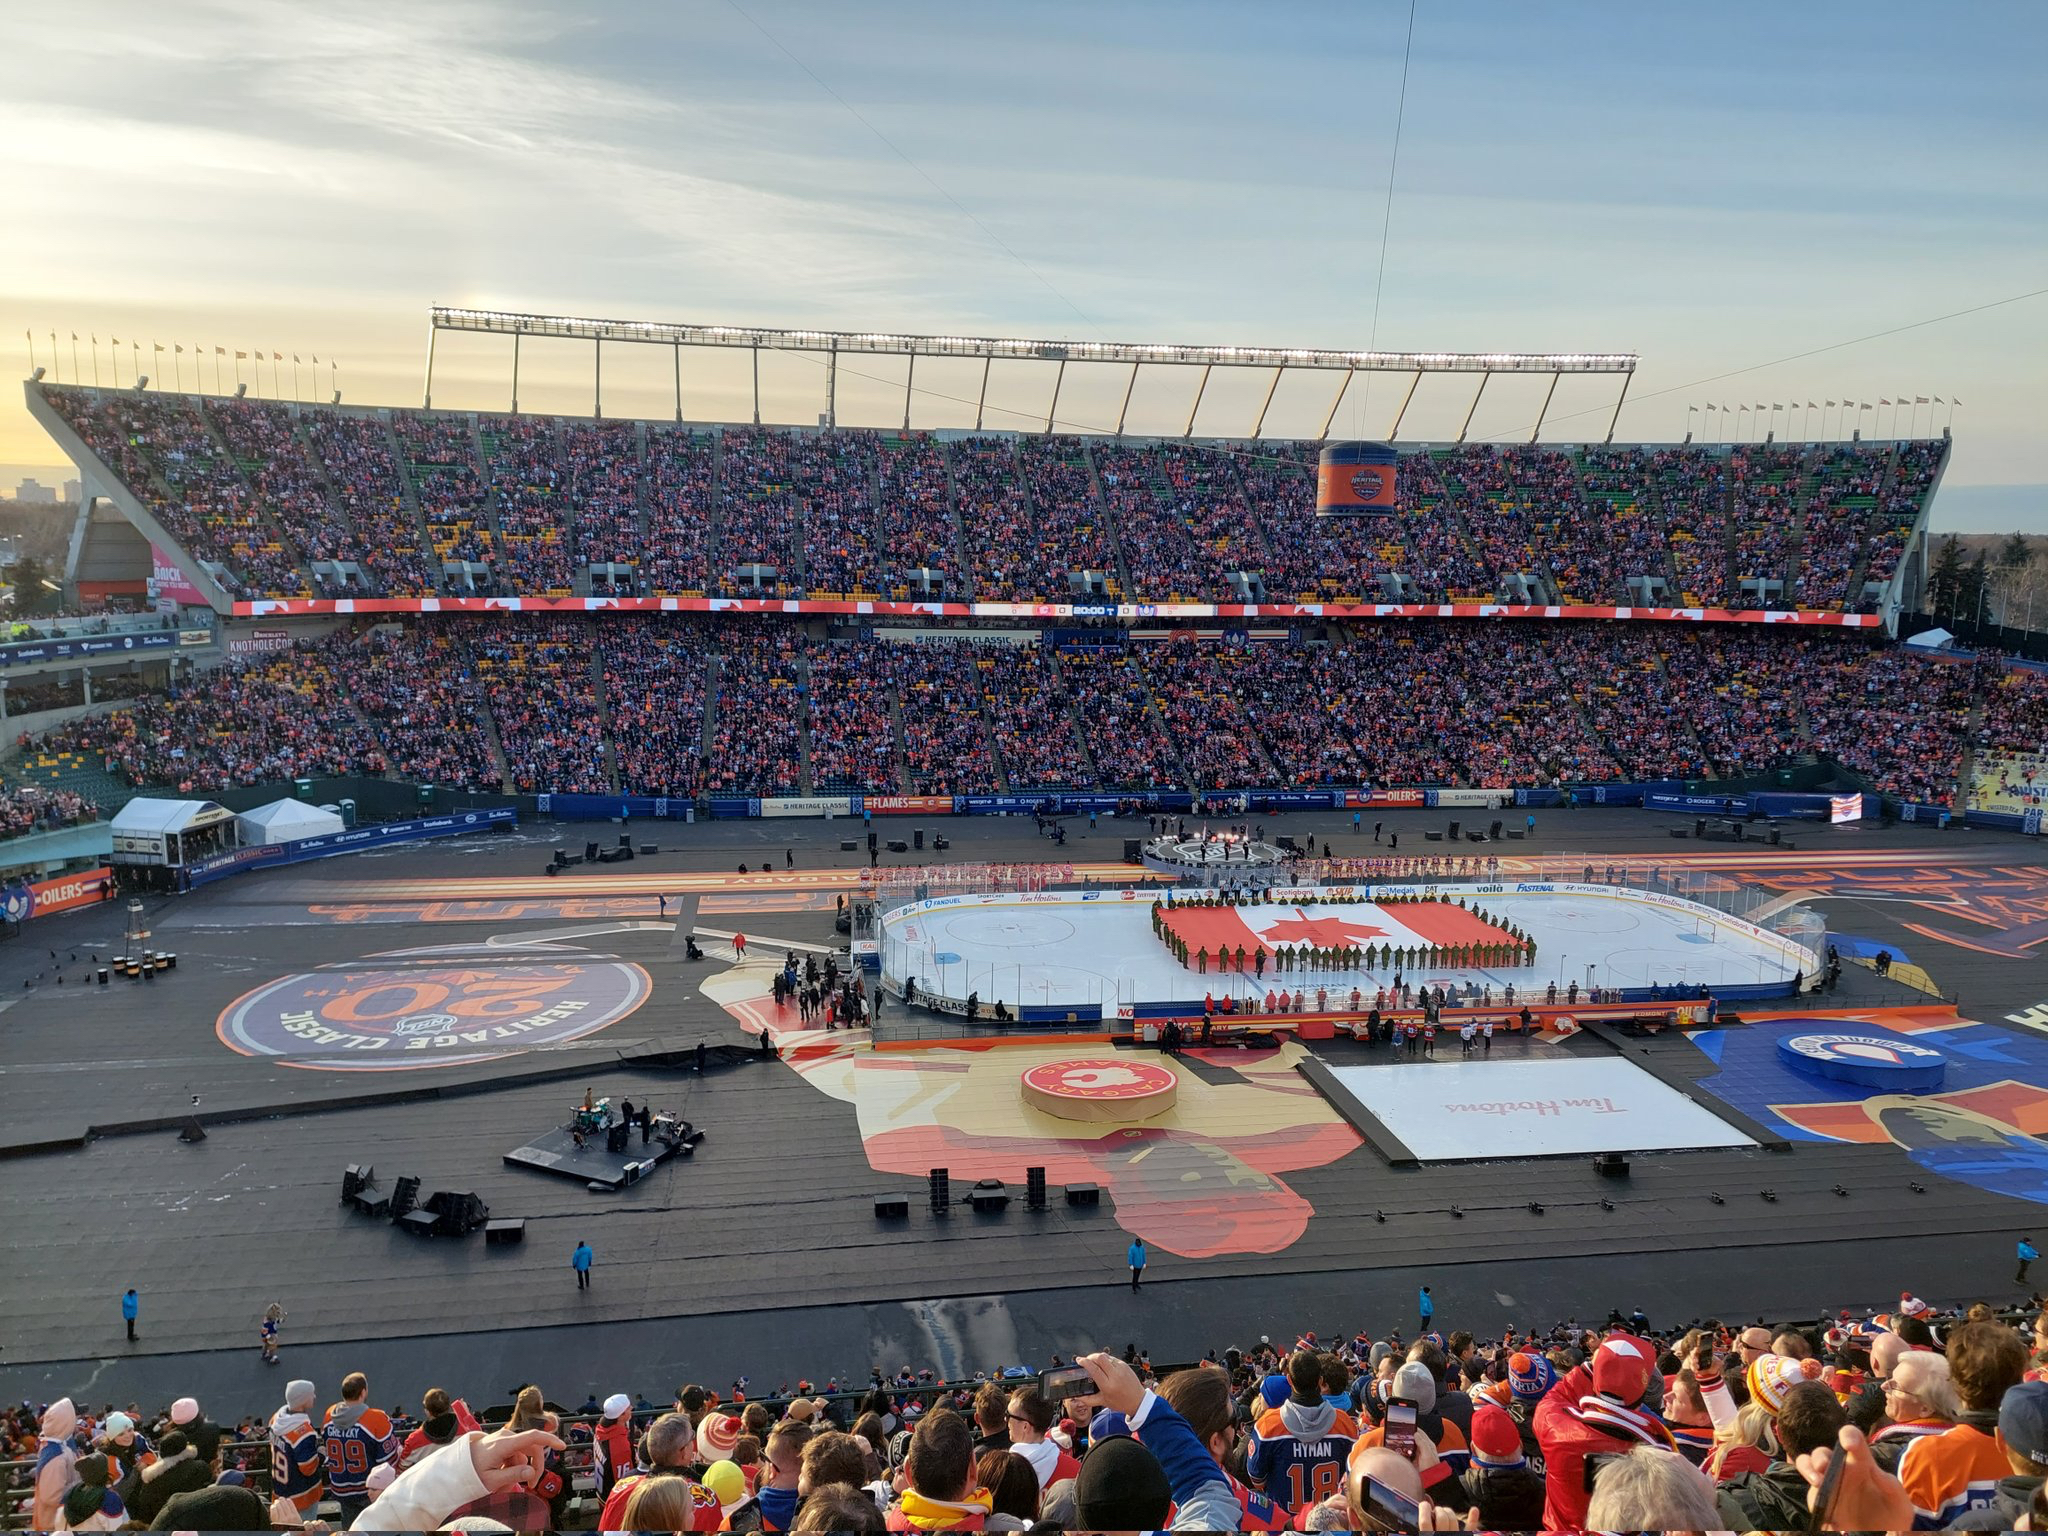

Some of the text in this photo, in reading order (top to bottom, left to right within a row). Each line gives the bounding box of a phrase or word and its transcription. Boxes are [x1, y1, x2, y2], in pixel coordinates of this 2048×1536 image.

[1074, 606, 1105, 615] 20:00
[230, 639, 274, 653] KNOTHOLE
[925, 635, 971, 645] HERITAGE
[972, 635, 1011, 645] CLASSIC
[1387, 790, 1417, 802] OILERS
[822, 802, 849, 810] CLASSIC
[872, 797, 909, 809] FLAMES
[423, 819, 453, 828] Scotiabank
[345, 831, 370, 841] HYUNDAI
[208, 855, 235, 870] HERITAGE
[42, 882, 83, 906] OILERS
[1276, 888, 1315, 897] Scotiabank
[1333, 887, 1354, 897] SKIP
[1389, 886, 1416, 895] Medals
[1424, 885, 1439, 896] CAT
[1477, 883, 1503, 893] voilà
[1516, 883, 1555, 893] FASTENAL
[933, 897, 961, 906] FANDUEL
[1020, 893, 1062, 903] Tim Hortons
[1643, 892, 1658, 903] Tim
[1658, 896, 1685, 909] Hortons
[1721, 914, 1750, 932] Scotiabank
[279, 1000, 590, 1049] HERITAGE CLASSIC
[1038, 1061, 1150, 1075] FLAMES
[1041, 1079, 1165, 1097] CALGARY
[1442, 1097, 1629, 1116] Tim Hortons
[327, 1426, 361, 1438] GRETZKY
[325, 1438, 369, 1473] 99
[1292, 1441, 1332, 1458] HYMAN
[1286, 1460, 1341, 1514] 18
